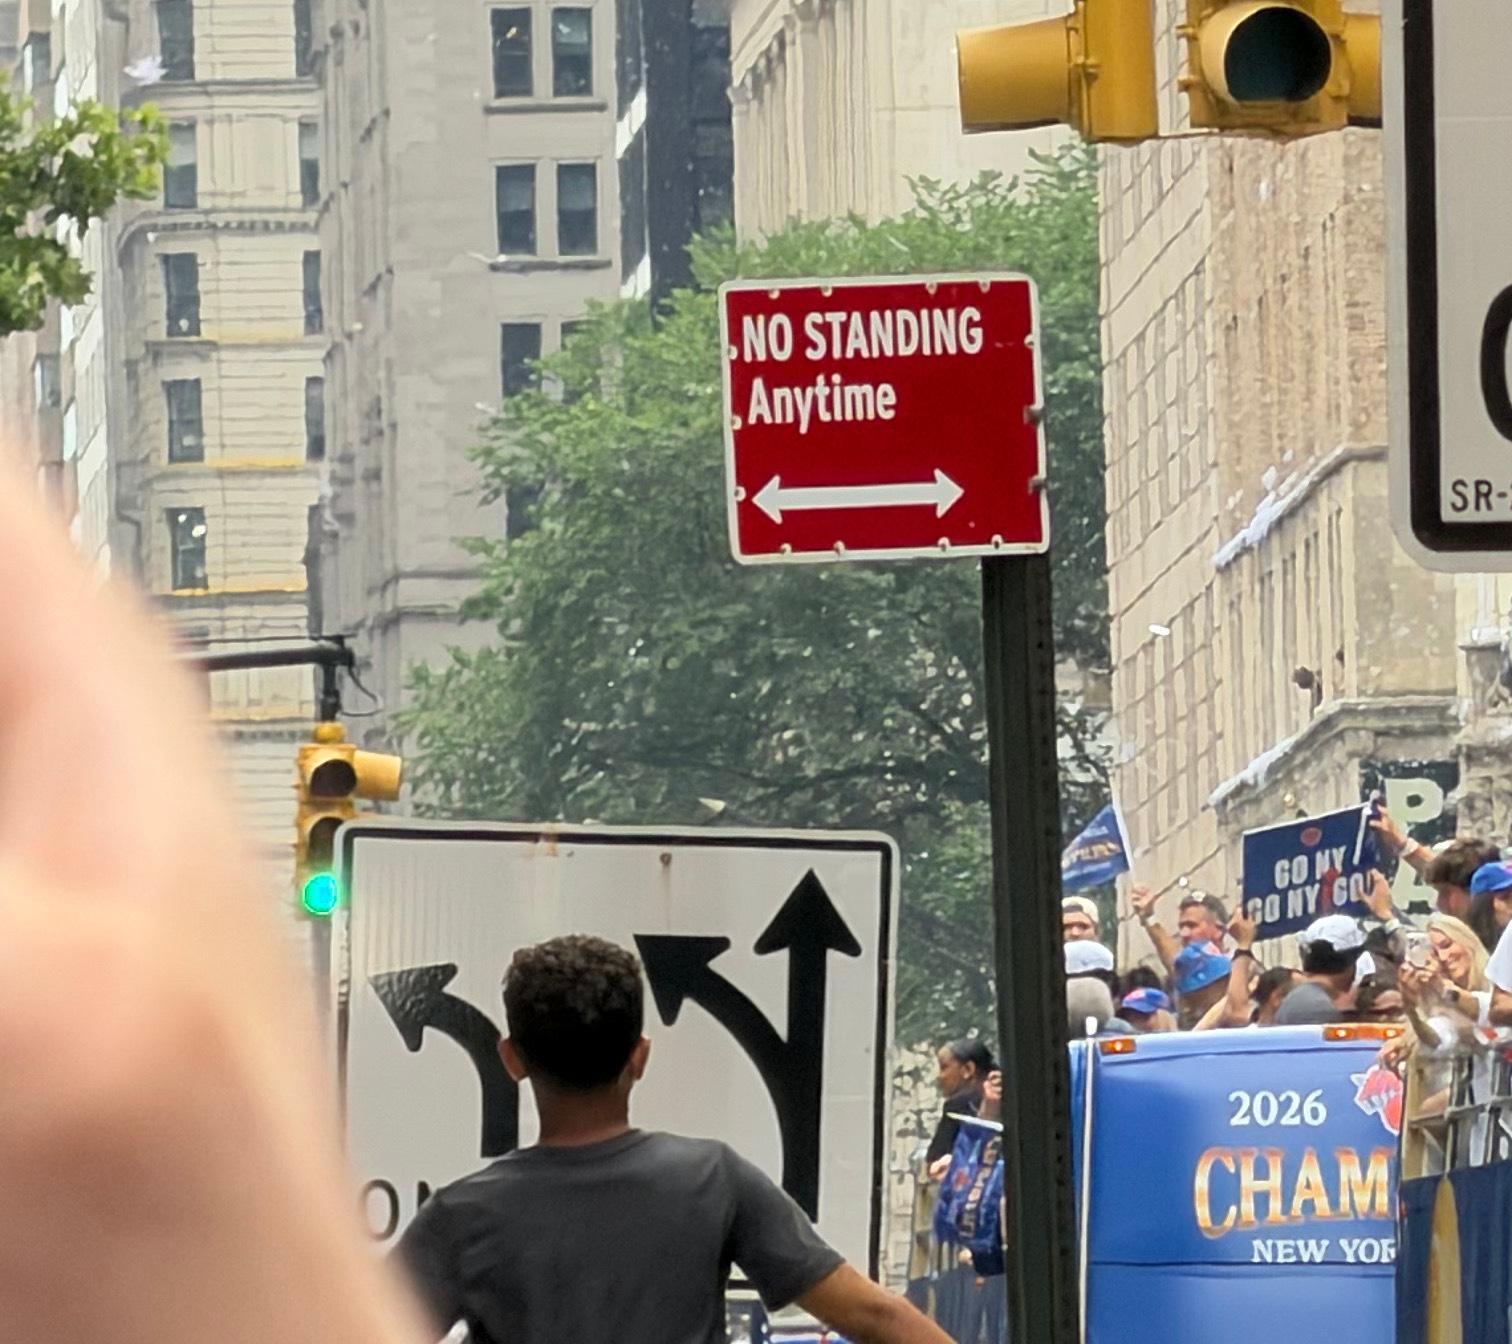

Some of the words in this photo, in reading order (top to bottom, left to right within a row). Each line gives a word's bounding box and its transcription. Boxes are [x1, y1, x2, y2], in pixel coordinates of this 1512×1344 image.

[742, 313, 793, 362] NO
[804, 306, 984, 360] STANDING
[748, 373, 897, 435] Anytime
[1274, 855, 1309, 890] GO
[1315, 845, 1347, 881] NY
[1246, 893, 1281, 925] GO
[1286, 883, 1321, 920] NY
[1228, 1088, 1328, 1127] 2026
[1251, 1238, 1330, 1264] NEW
